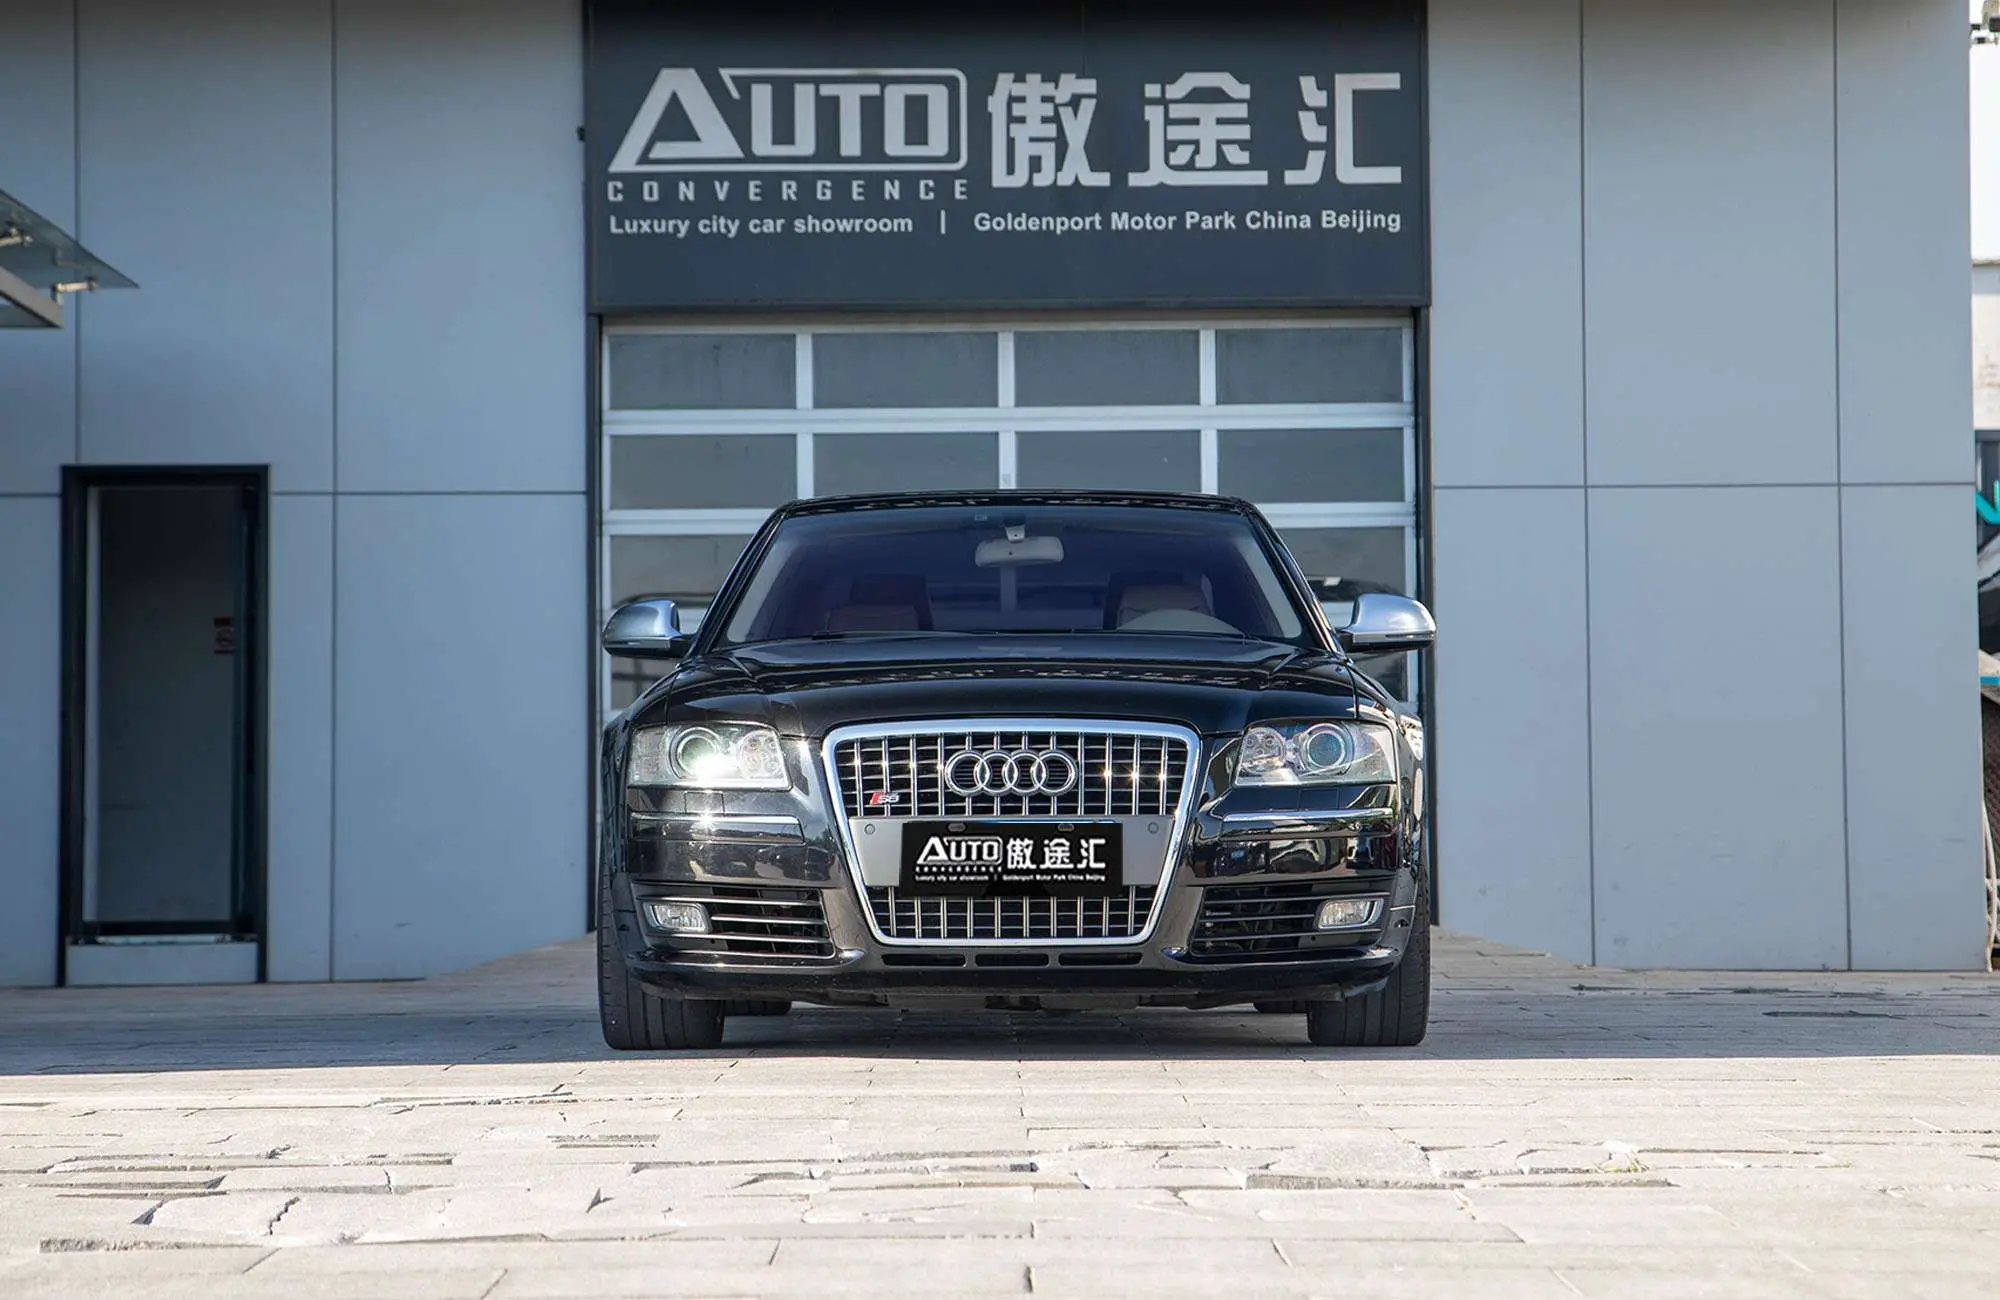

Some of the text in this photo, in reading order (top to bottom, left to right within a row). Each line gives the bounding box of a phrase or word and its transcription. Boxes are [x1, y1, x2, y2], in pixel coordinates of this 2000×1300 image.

[608, 67, 950, 173] AUTO
[988, 71, 1402, 188] 傲途汇
[607, 179, 968, 202] CONVERGENCE
[609, 210, 1401, 238] Luxury city car showroom Goldenport Motor Park China Beijing
[916, 836, 999, 865] AUTO
[1006, 837, 1107, 869] 傲途汇
